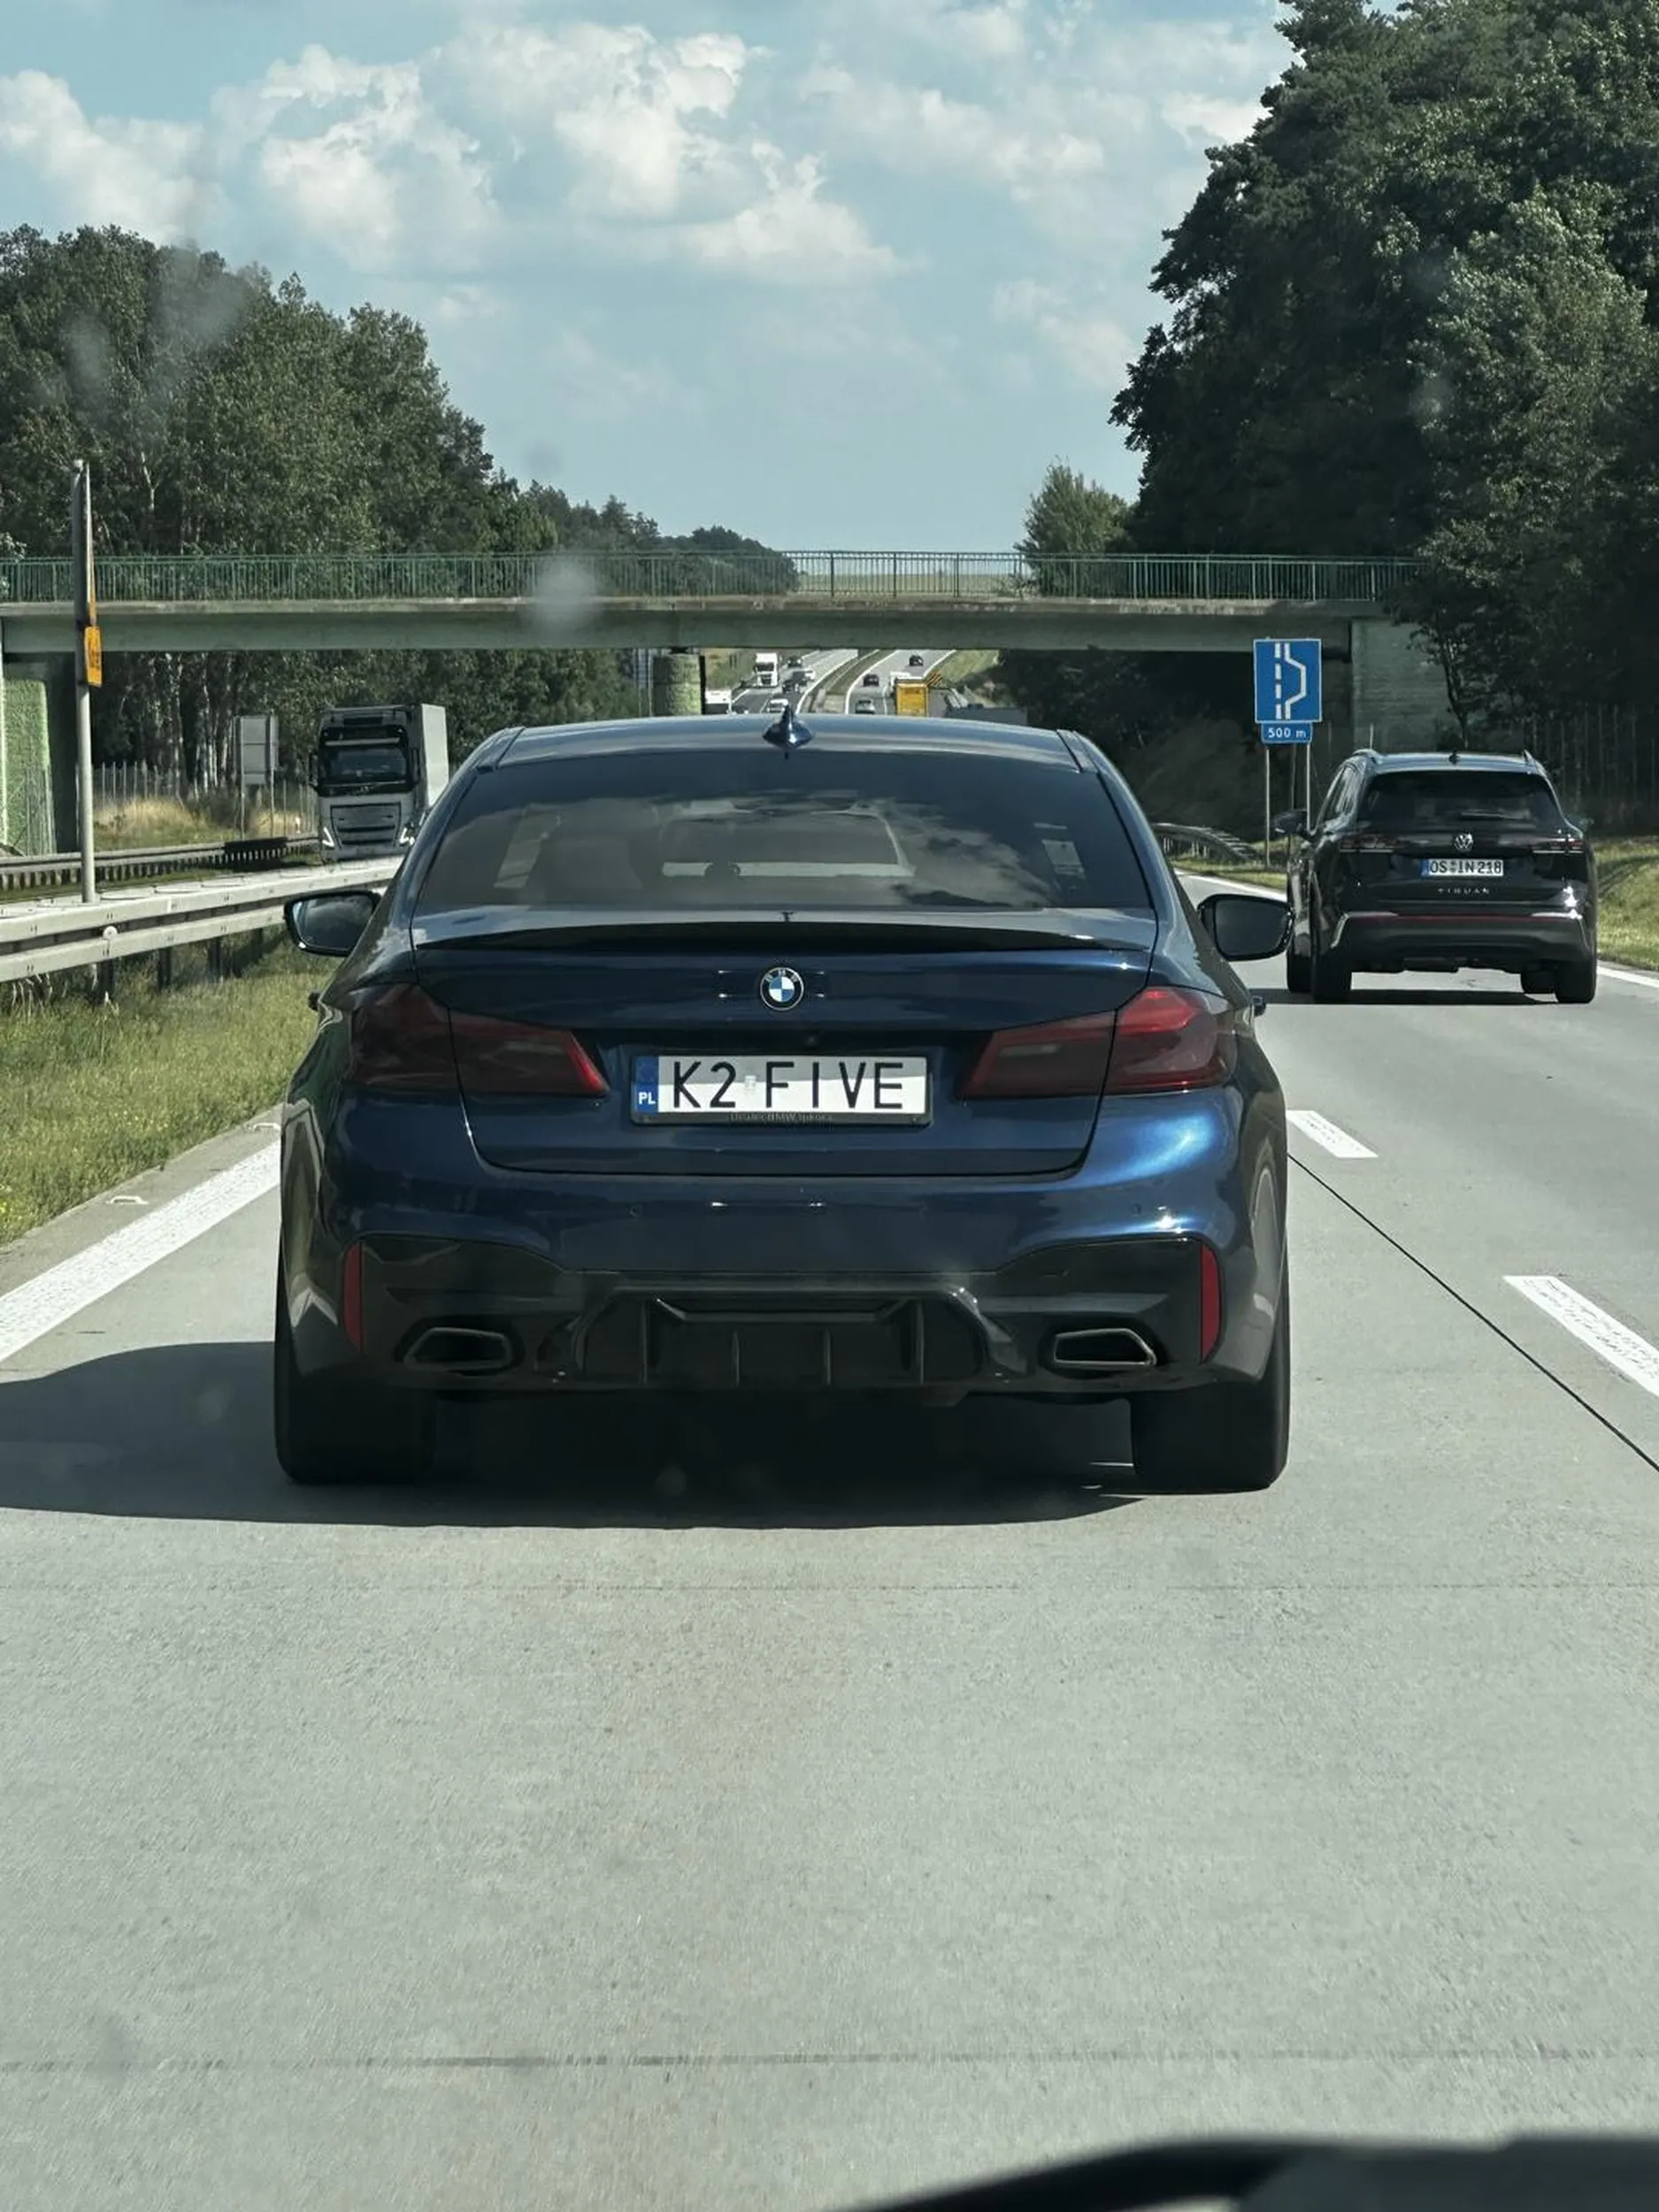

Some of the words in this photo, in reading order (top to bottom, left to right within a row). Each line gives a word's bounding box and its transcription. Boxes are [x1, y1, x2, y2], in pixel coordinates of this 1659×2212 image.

[1268, 726, 1291, 739] 500
[1295, 729, 1306, 739] m
[1431, 860, 1448, 874] OS
[672, 1061, 737, 1109] K2
[765, 1061, 904, 1109] FIVE
[639, 1091, 657, 1105] PL
